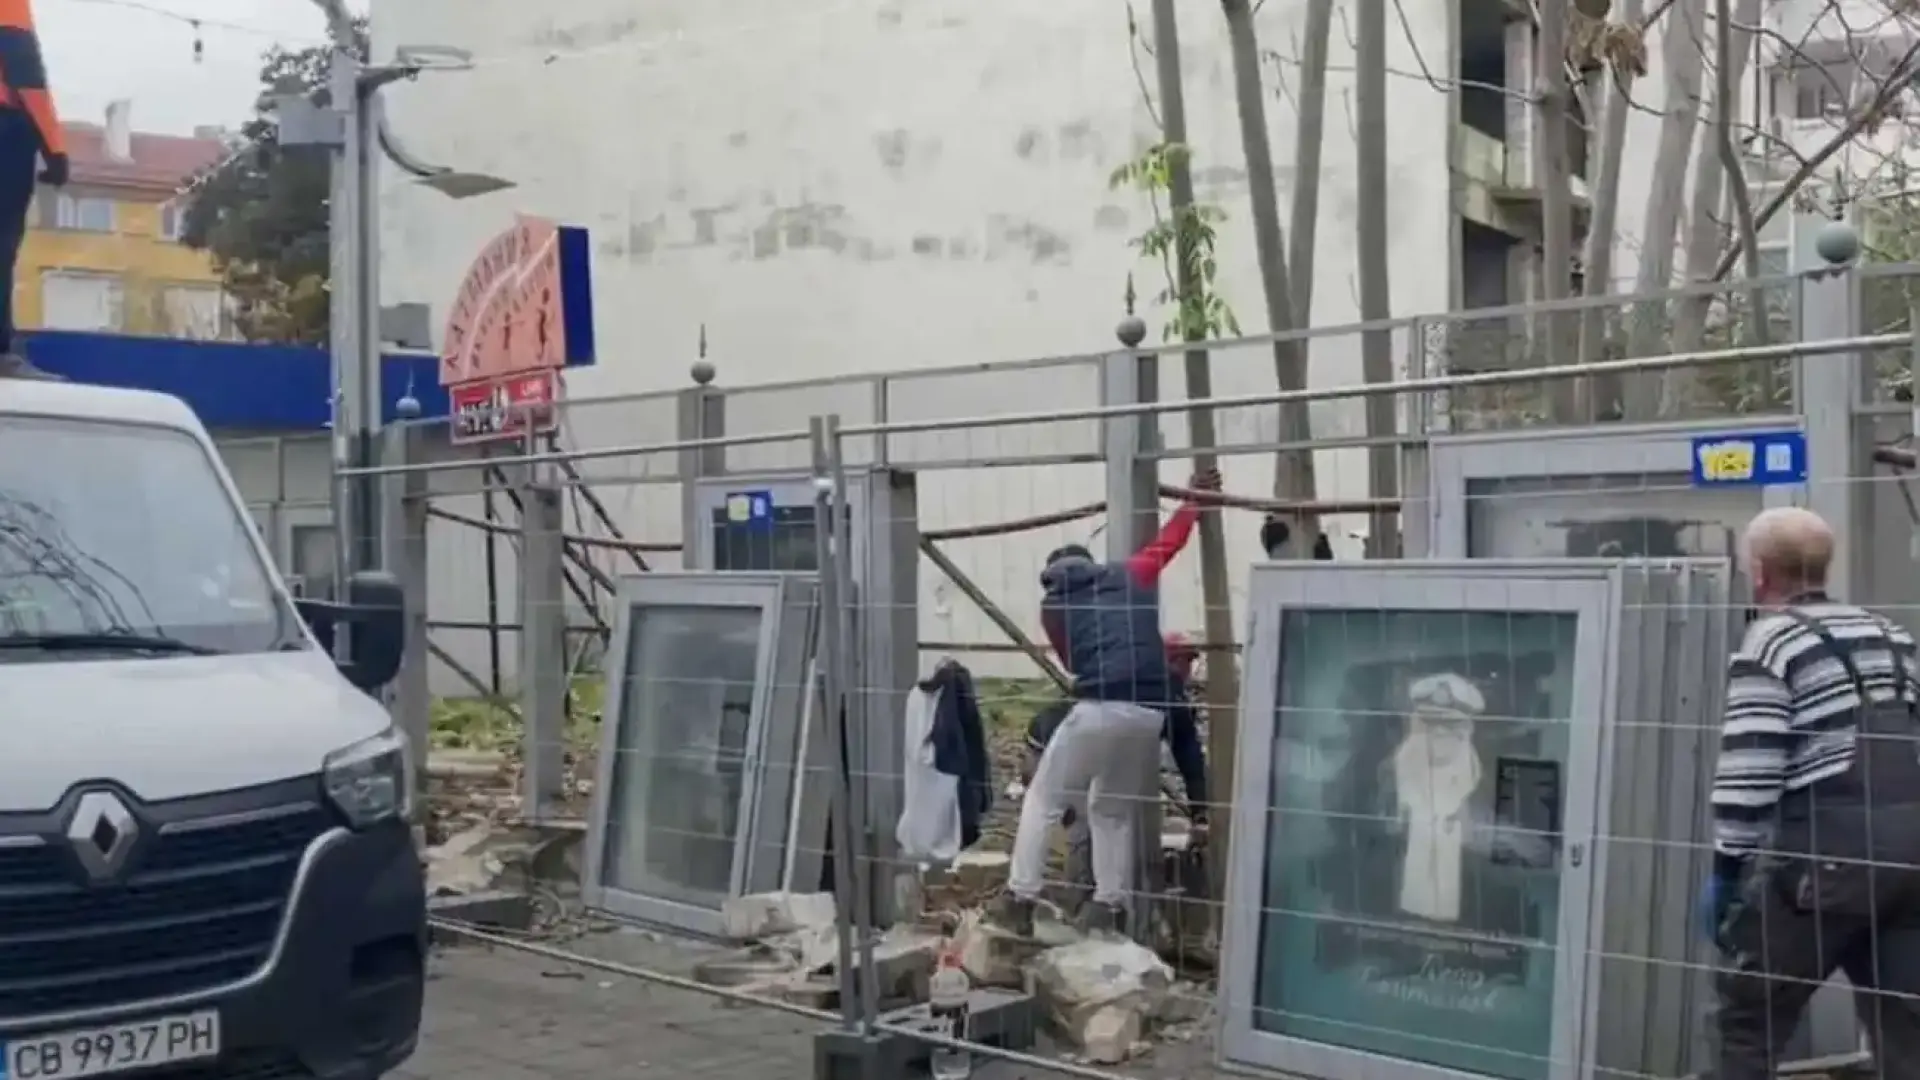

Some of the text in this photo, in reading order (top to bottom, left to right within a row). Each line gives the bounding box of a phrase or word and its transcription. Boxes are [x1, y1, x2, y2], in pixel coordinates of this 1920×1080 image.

[15, 1017, 213, 1079] CB 9937 PH
